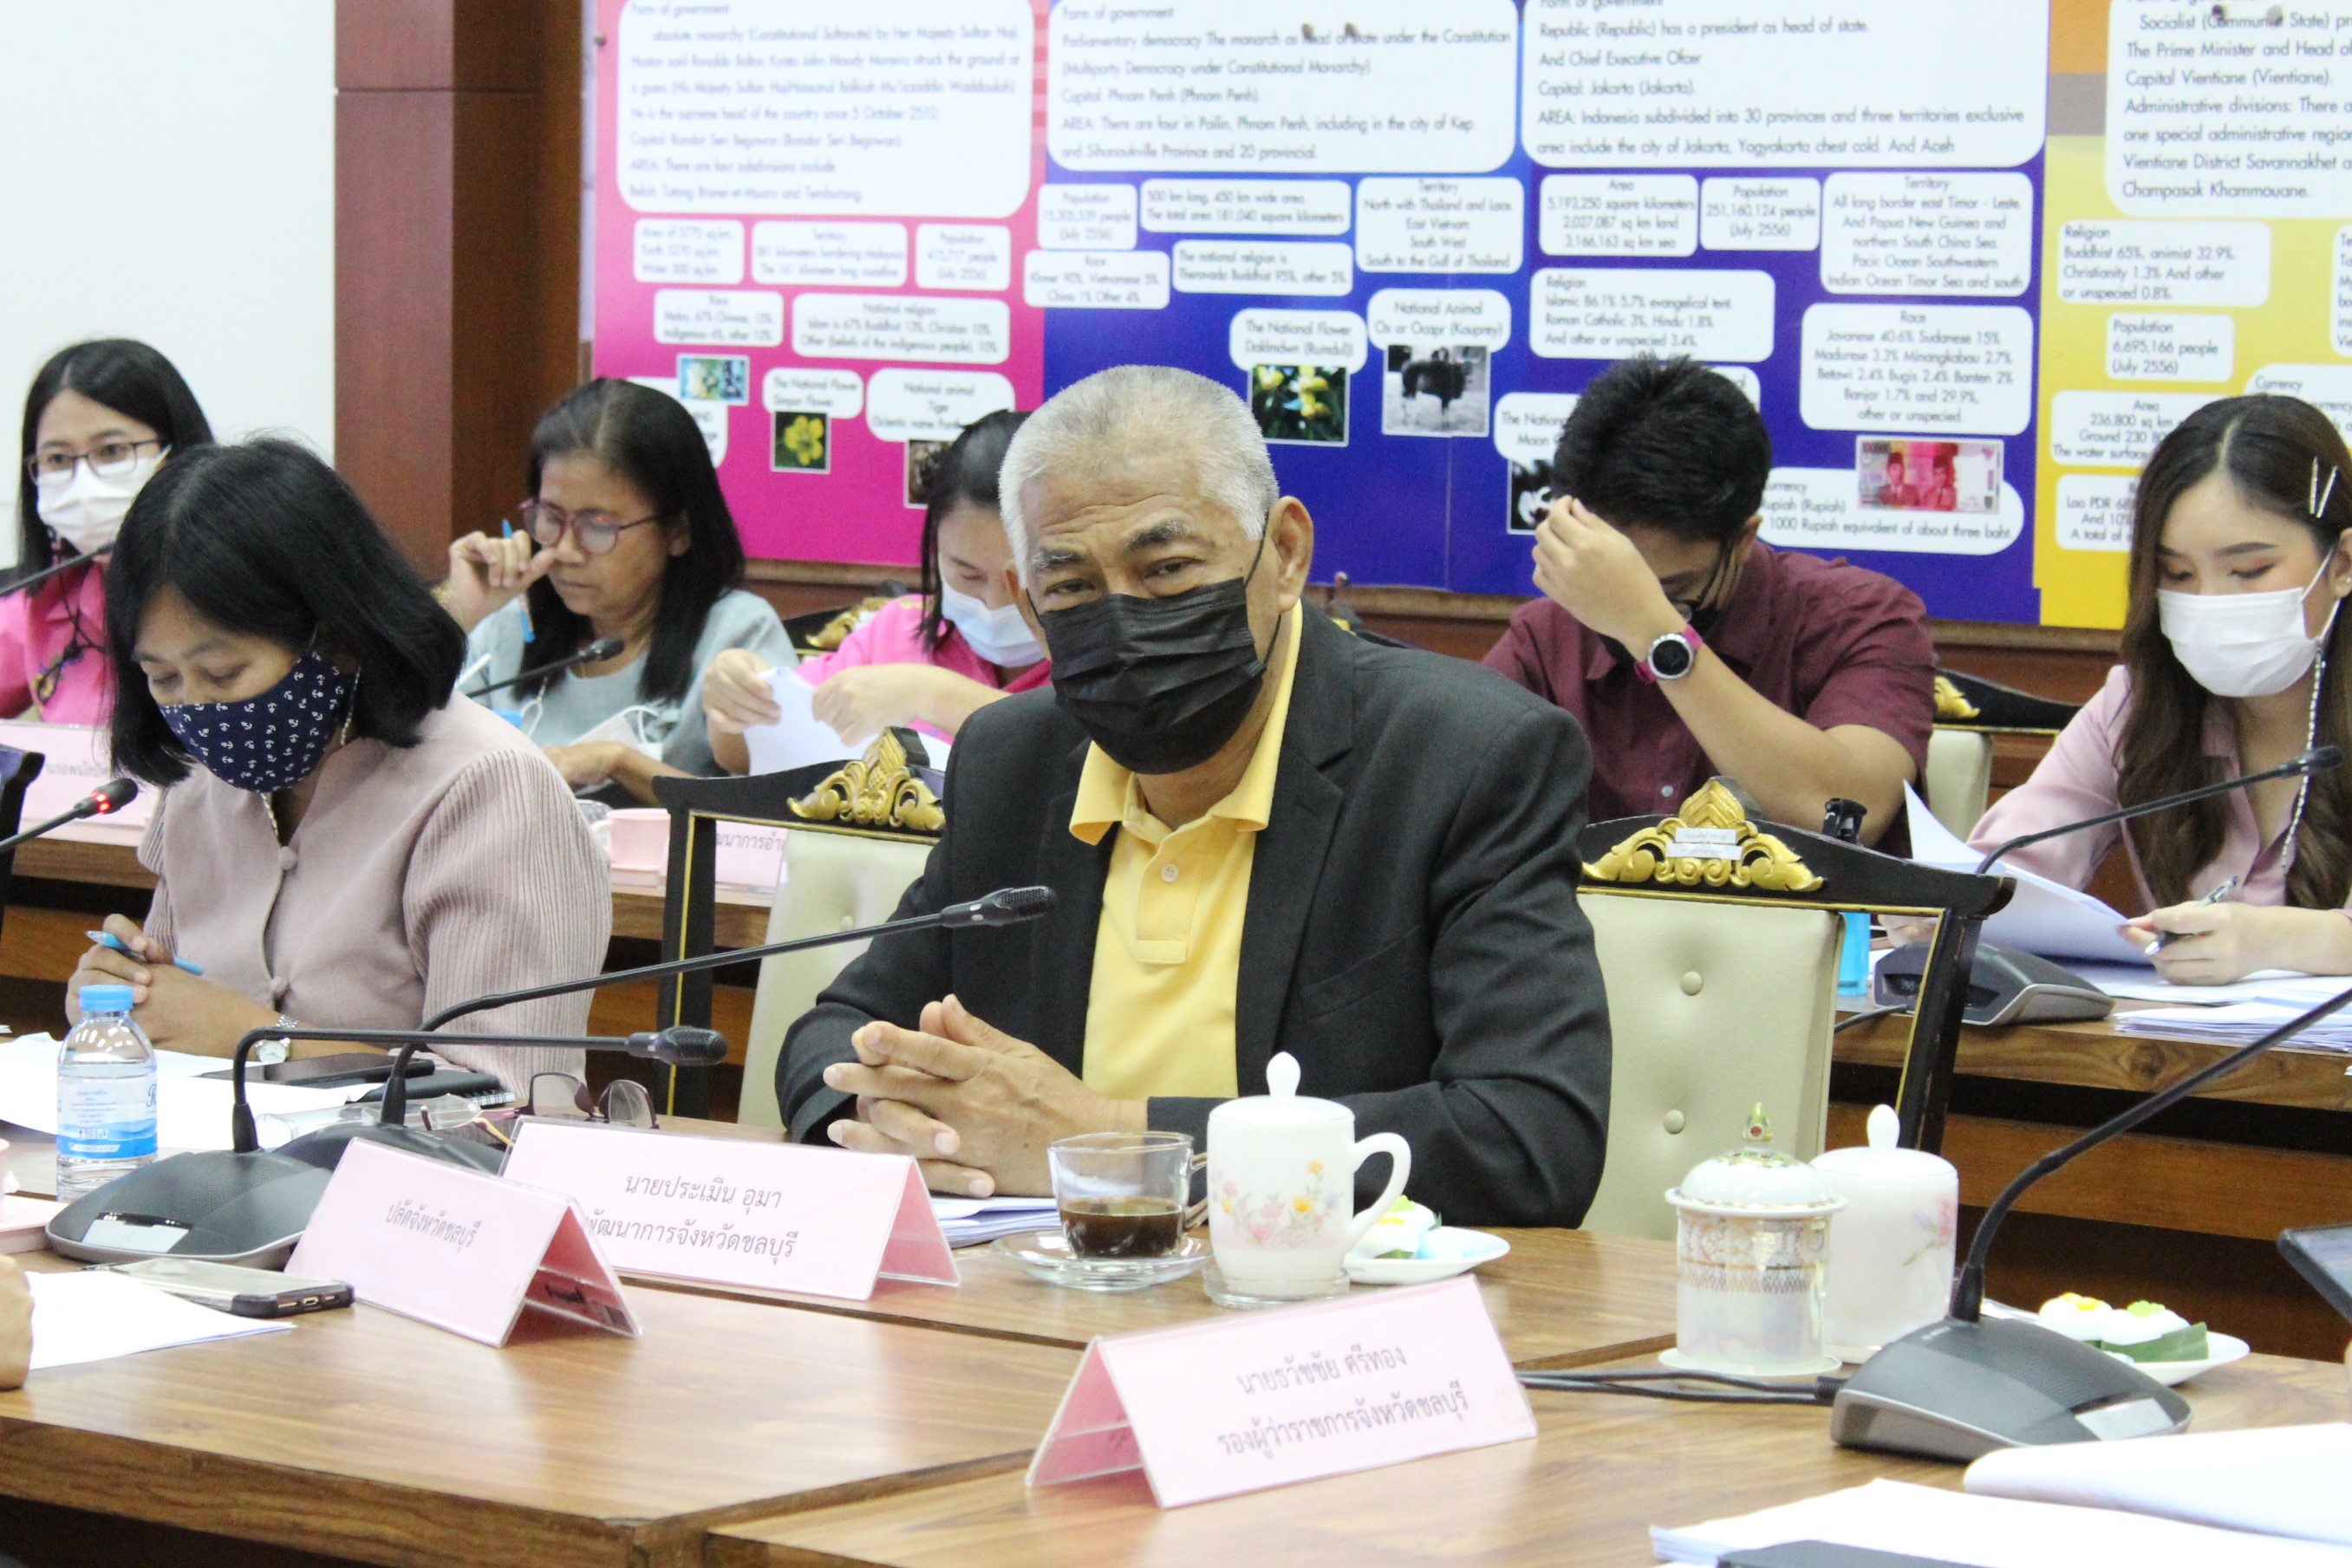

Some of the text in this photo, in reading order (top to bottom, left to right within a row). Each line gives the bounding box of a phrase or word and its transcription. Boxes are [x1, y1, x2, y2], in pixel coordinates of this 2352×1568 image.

[1539, 20, 1591, 38] Republic
[1594, 19, 1657, 38] (Republic)
[1660, 19, 1684, 36] has
[1686, 24, 1697, 36] a
[1700, 18, 1759, 38] president
[1762, 23, 1778, 35] as
[1782, 17, 1815, 34] head
[1819, 17, 1834, 34] of
[2140, 11, 2330, 30] Socialist State)
[2127, 38, 2335, 59] The Prime Minister and Head
[1538, 49, 1566, 67] And
[1568, 49, 1602, 67] Chief
[1606, 49, 1663, 67] Executive
[1589, 80, 1635, 96] Jakarta
[2125, 68, 2176, 90] Capital
[2181, 68, 2247, 86] Vientiane
[2124, 96, 2224, 114] Administrative
[2299, 96, 2339, 114] There
[1580, 108, 1640, 125] Indonesia
[1644, 108, 1711, 125] subdivided
[1716, 109, 1740, 124] into
[1744, 108, 1762, 124] 30
[1766, 108, 1827, 127] provinces
[1830, 108, 1857, 123] and
[1860, 108, 1894, 123] three
[1899, 108, 1960, 123] territories
[1964, 108, 2025, 123] exclusive
[2123, 130, 2150, 142] one
[2155, 124, 2204, 145] special
[2207, 124, 2307, 142] administrative
[1536, 143, 1566, 154] area
[1569, 138, 1613, 154] include
[1617, 138, 1637, 154] the
[1640, 139, 1663, 158] city
[1666, 138, 1680, 154] of
[1737, 138, 1811, 159] Yogyakarta
[1814, 139, 1848, 153] chest
[1888, 139, 1917, 153] And
[1920, 139, 1955, 153] Aceh
[2123, 153, 2338, 171] Vientiane District Savannakhet
[1733, 185, 1789, 203] Population
[2121, 180, 2204, 201] Champasak
[1779, 205, 1817, 221] people
[1730, 223, 1791, 240] (July 2556)
[2065, 224, 2111, 243] Religion
[2064, 246, 2114, 259] Buddhist
[2149, 247, 2192, 260] animist
[2063, 265, 2128, 283] Christianity
[2166, 265, 2192, 281] And
[2194, 265, 2225, 281] other
[2062, 289, 2075, 298] or
[1899, 309, 1927, 324] Race
[2114, 318, 2174, 336] Population
[1827, 329, 1876, 342] Javanese
[1919, 329, 1972, 345] Sudanese
[1814, 348, 1868, 361] Madurese
[2178, 339, 2219, 358] people
[1817, 366, 1853, 381] Betawi
[1888, 368, 1919, 382] Bugis
[1953, 369, 1992, 384] Banten
[2112, 360, 2179, 377] (July 2556)
[2255, 375, 2303, 394] Currency
[1843, 386, 1880, 402] Banjar
[1914, 387, 1938, 403] and
[1857, 406, 1886, 420] other
[1890, 411, 1903, 421] or
[2133, 400, 2160, 413] Area
[2140, 418, 2153, 431] sq
[2156, 416, 2175, 432] km
[2078, 430, 2147, 446] Ground 230
[2055, 445, 2072, 457] The
[2075, 447, 2106, 459] water
[2066, 498, 2112, 512] Lao PDR
[1770, 516, 1798, 530] 1000
[1801, 517, 1840, 534] Rupiah
[1842, 519, 1899, 536] equivalent
[1901, 520, 1913, 536] of
[1917, 521, 1950, 537] about
[1952, 523, 1981, 538] three
[2081, 513, 2105, 525] And
[2070, 529, 2122, 542] A total of
[625, 1175, 782, 1215] นายประเมิน อุมา
[386, 1199, 483, 1255] ปลัดจังหวัดชลบุรี
[1236, 1344, 1408, 1394] นายธวัชชัย ศรีทอง
[1217, 1380, 1469, 1460] รองผู้ว่าราชการจังหวัดชลบุรี
